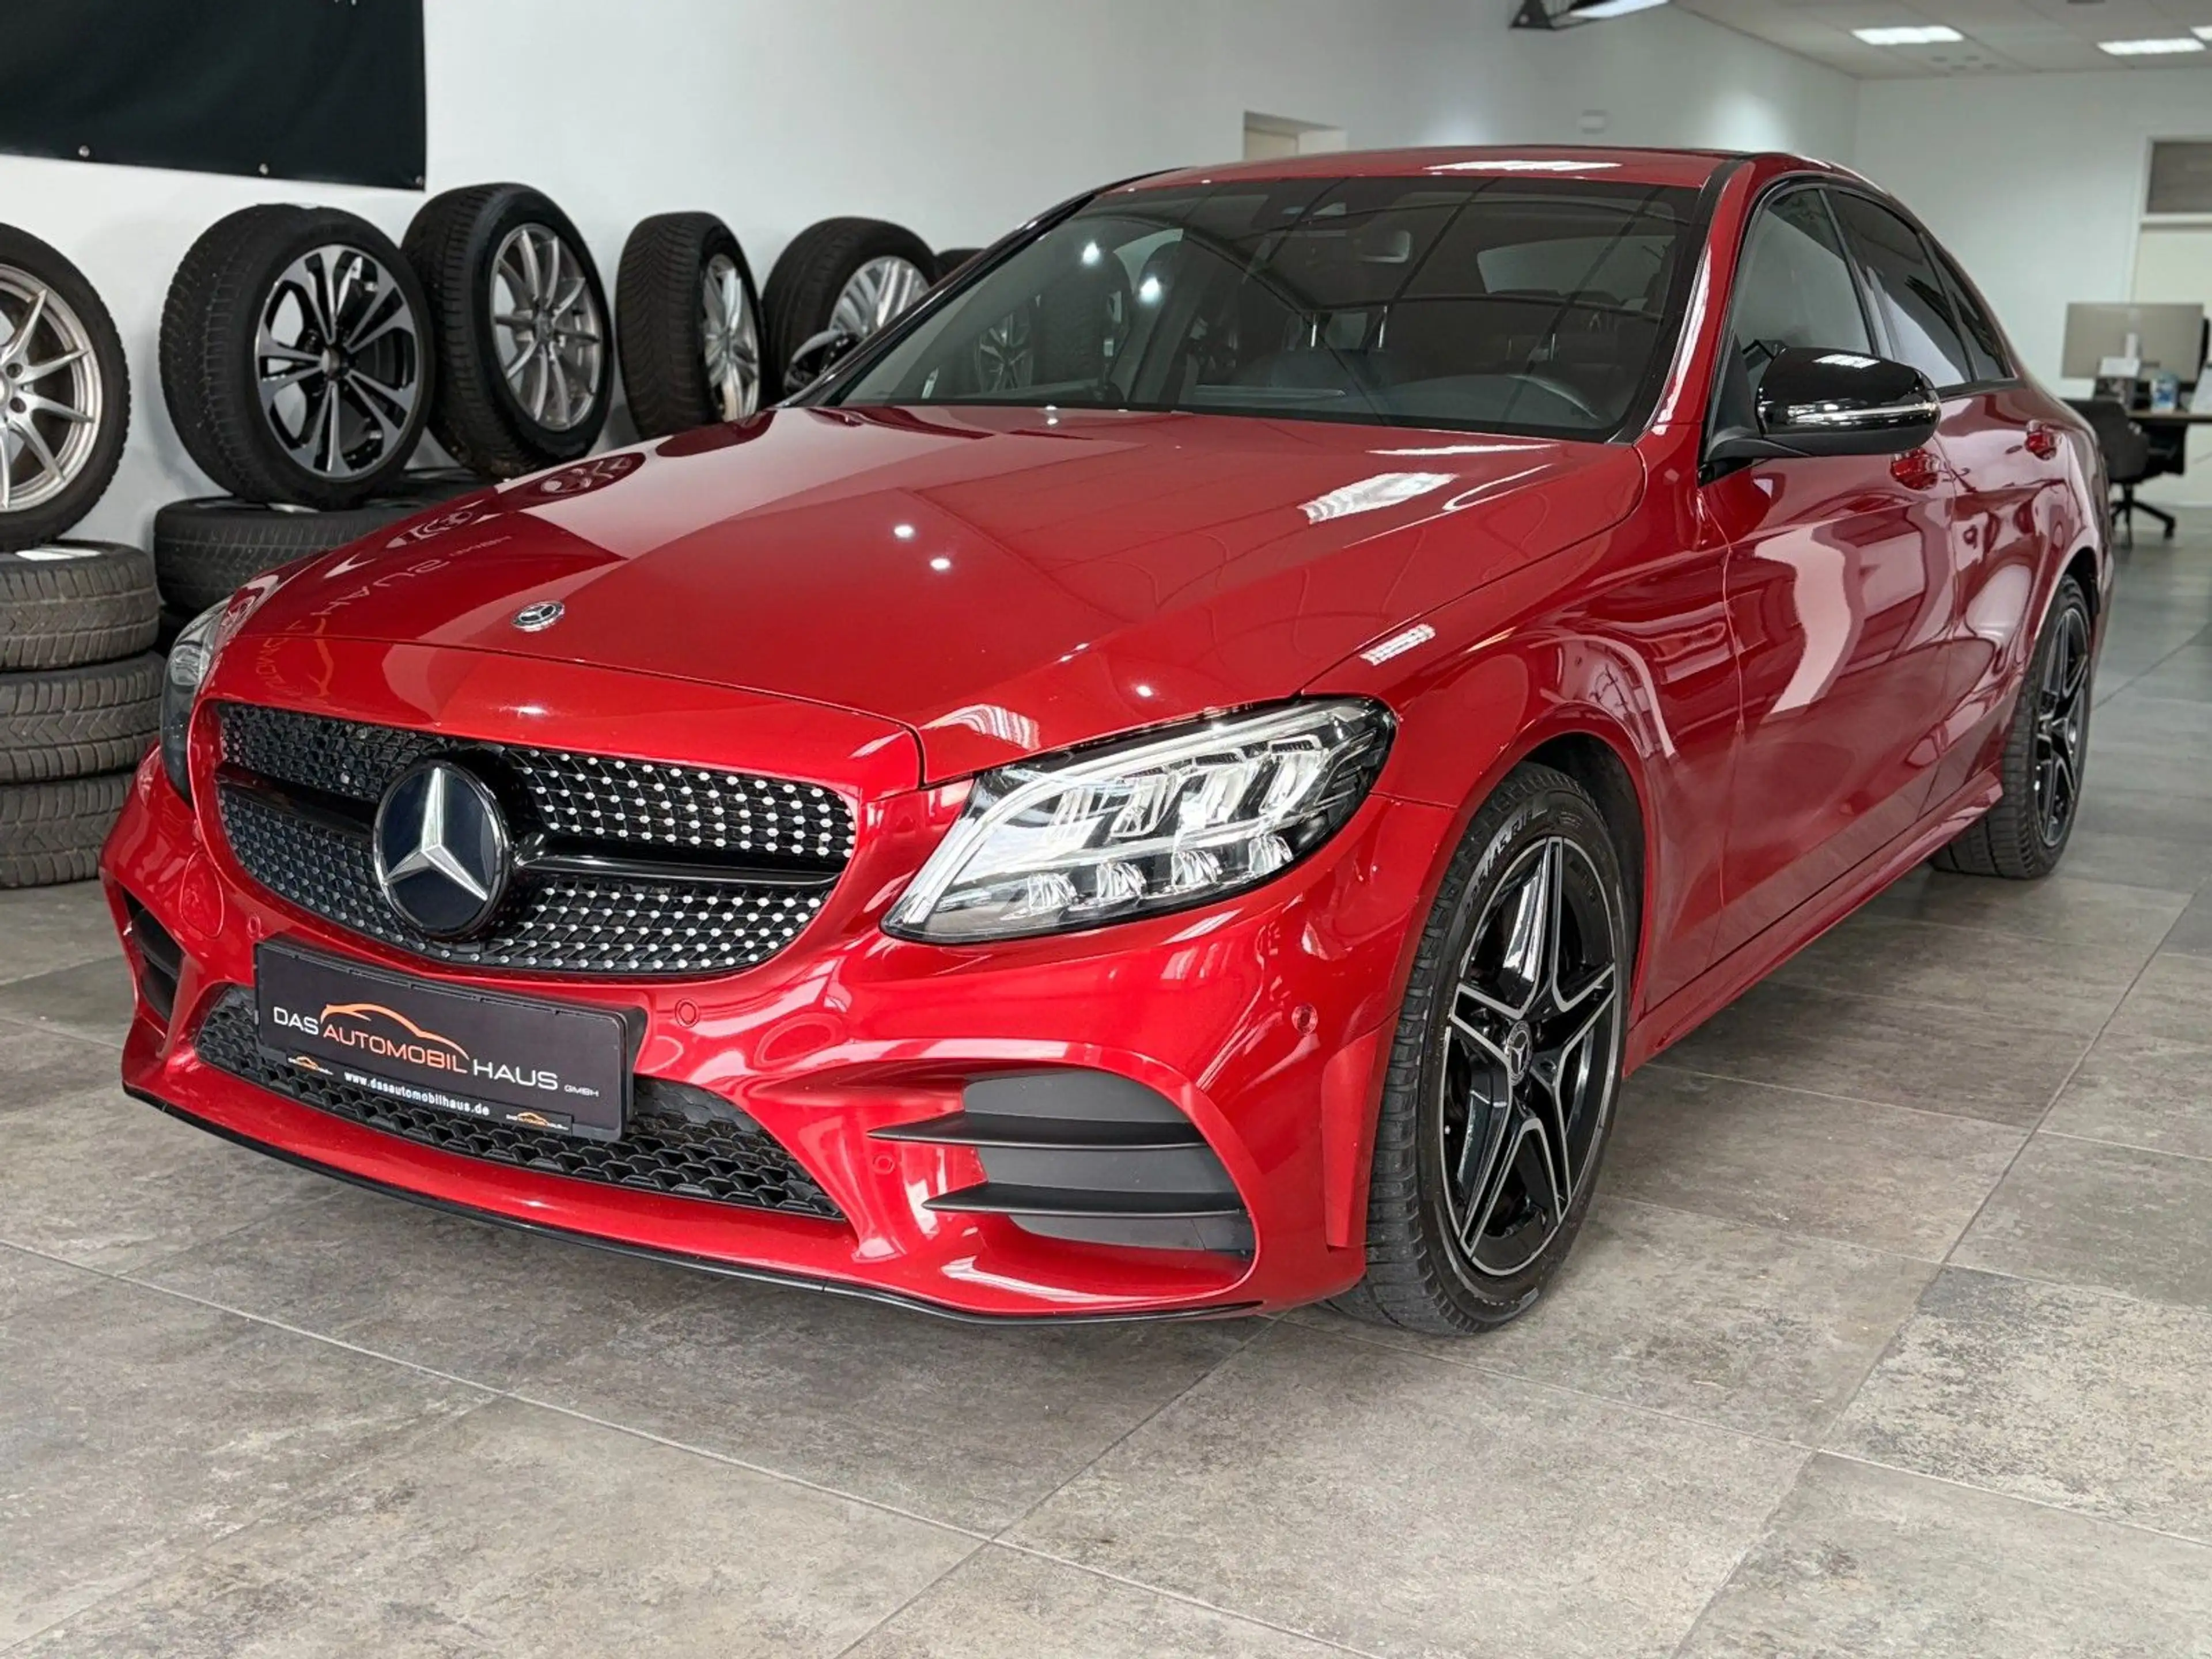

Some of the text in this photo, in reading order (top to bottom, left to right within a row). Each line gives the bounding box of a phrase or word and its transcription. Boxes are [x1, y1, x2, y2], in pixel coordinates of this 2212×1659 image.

[274, 1006, 319, 1035] DAS
[323, 1024, 468, 1074] AUTOMOBIL
[473, 1058, 558, 1090] HAUS
[344, 1071, 489, 1116] www.dasautomobilhaus.de
